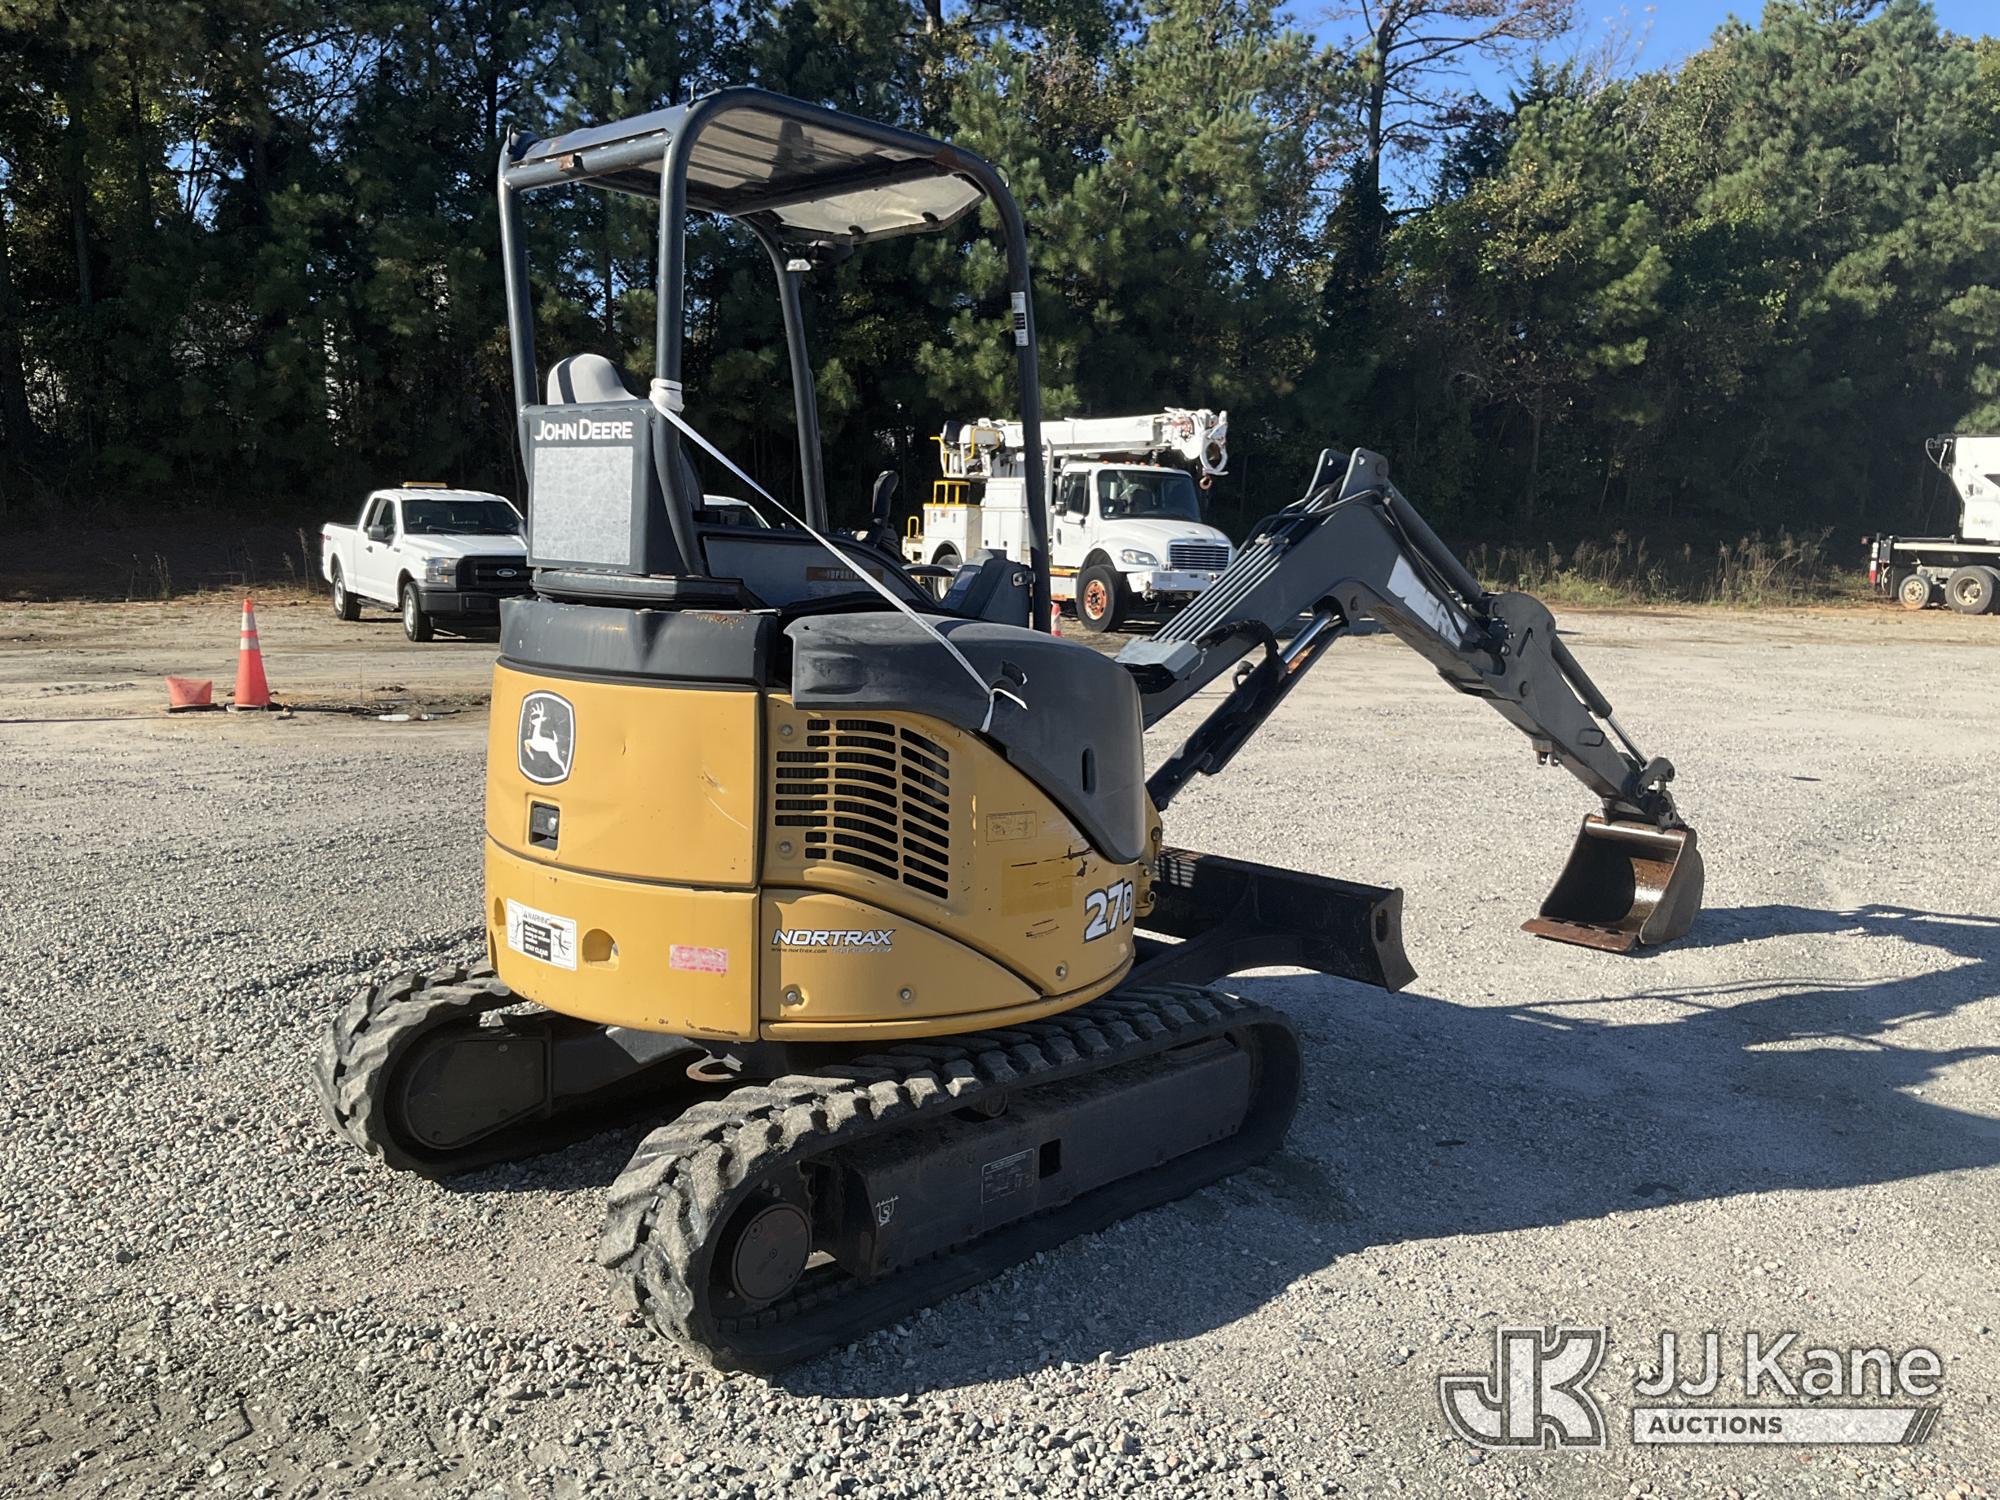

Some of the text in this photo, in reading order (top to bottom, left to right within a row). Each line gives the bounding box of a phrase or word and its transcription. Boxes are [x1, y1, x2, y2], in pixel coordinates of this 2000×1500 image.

[534, 418, 633, 441] JOHN DEERE
[1084, 878, 1134, 943] 27D
[771, 928, 896, 947] NORTRAX
